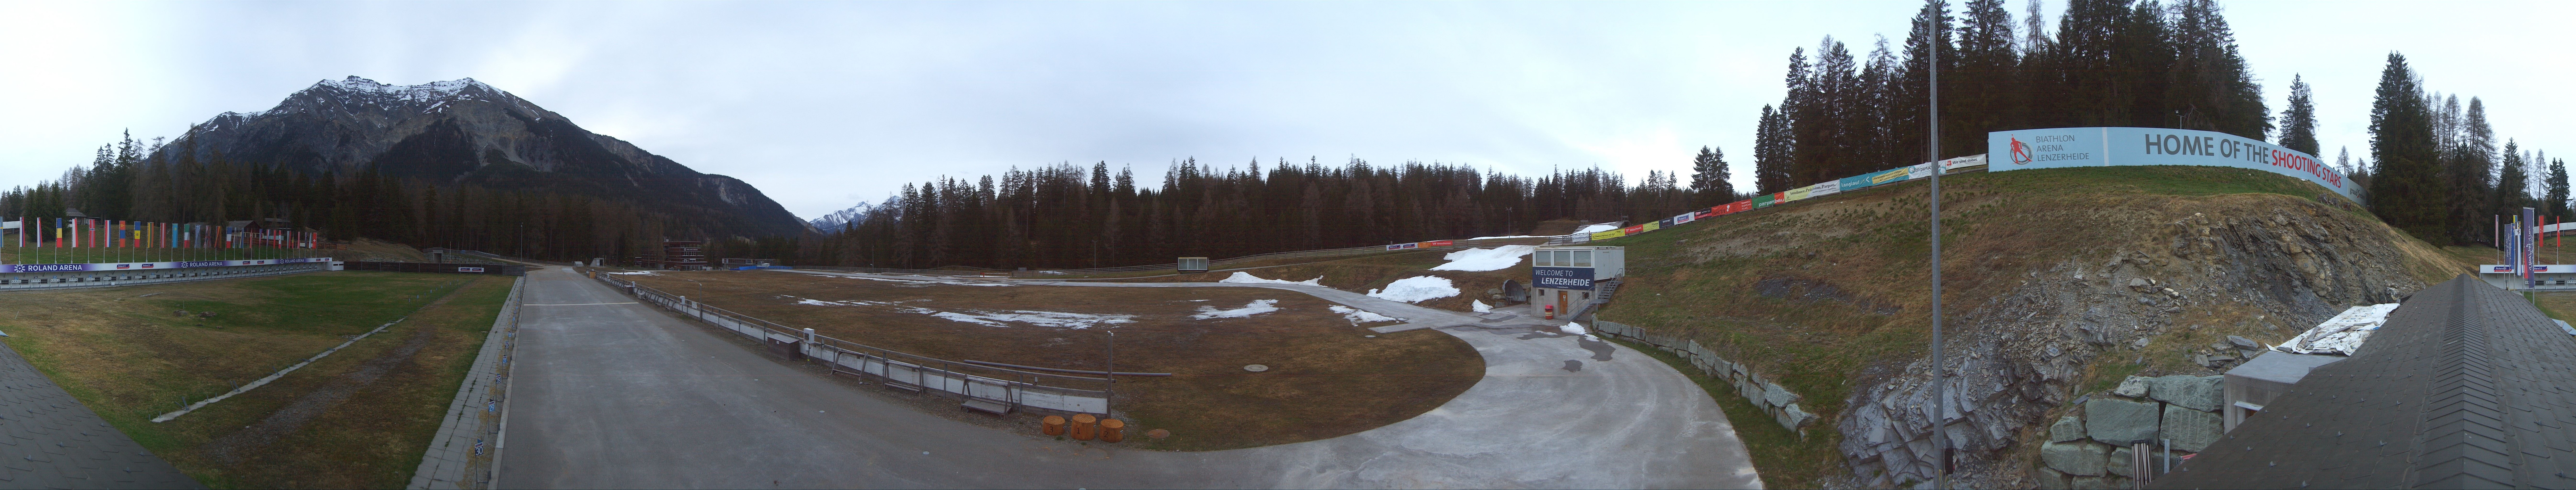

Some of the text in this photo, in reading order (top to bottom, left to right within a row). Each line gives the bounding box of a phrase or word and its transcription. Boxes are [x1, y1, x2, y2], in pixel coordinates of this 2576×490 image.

[2037, 153, 2089, 161] LENZERHEIDE
[2145, 134, 2341, 188] HOME OF THE SHOOTING STARS
[1841, 179, 1865, 187] langlauf.ch
[1759, 198, 1784, 207] parpanbau
[1541, 277, 1590, 286] LENZERHEIDE
[476, 446, 483, 455] 30
